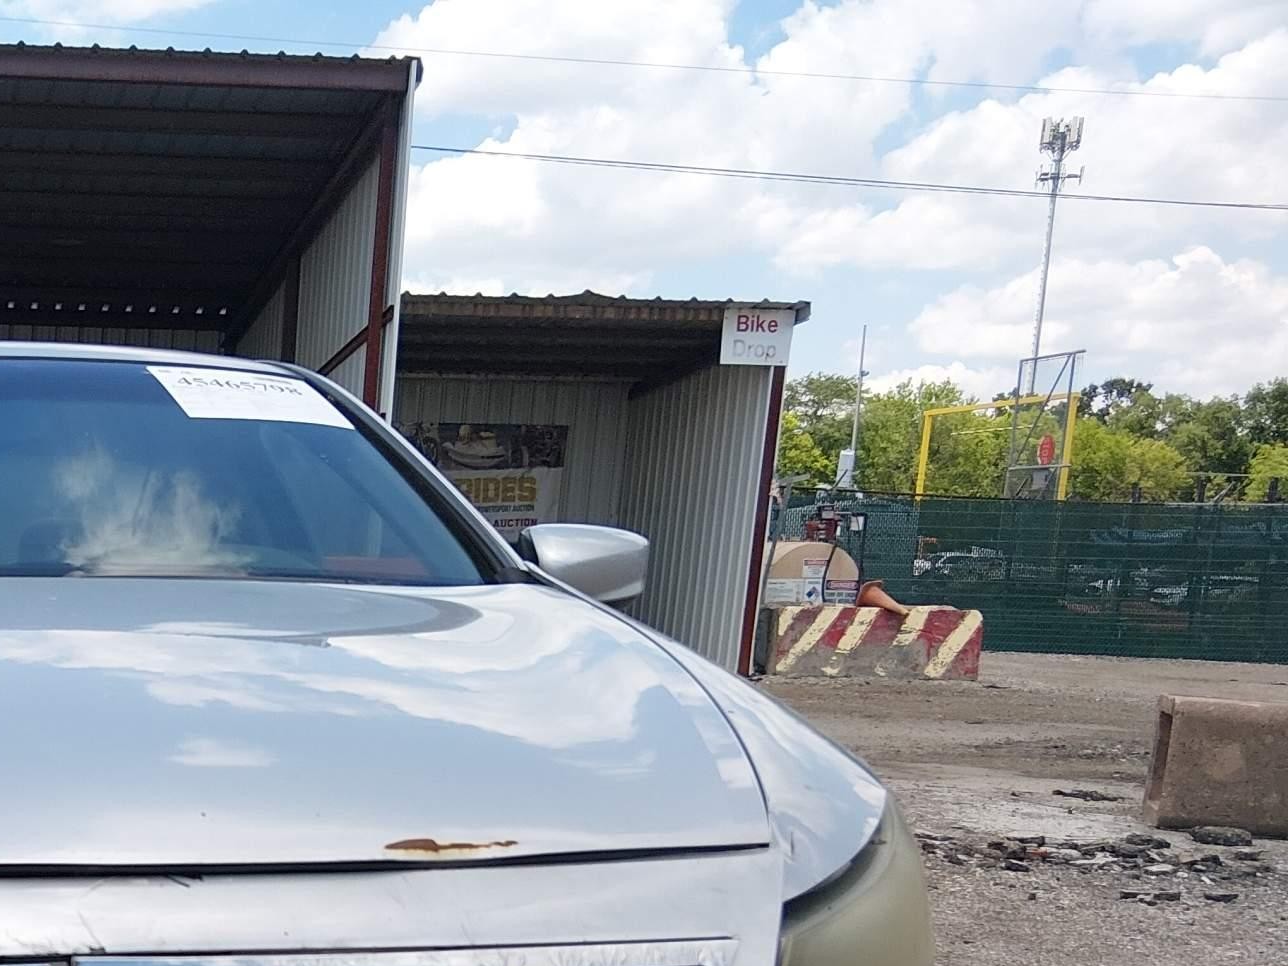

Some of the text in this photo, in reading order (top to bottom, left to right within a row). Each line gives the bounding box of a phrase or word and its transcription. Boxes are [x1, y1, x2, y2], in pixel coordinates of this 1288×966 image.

[736, 314, 779, 333] Bike
[732, 339, 777, 360] Drop
[177, 376, 303, 396] 45465798
[493, 517, 538, 528] AUCTION
